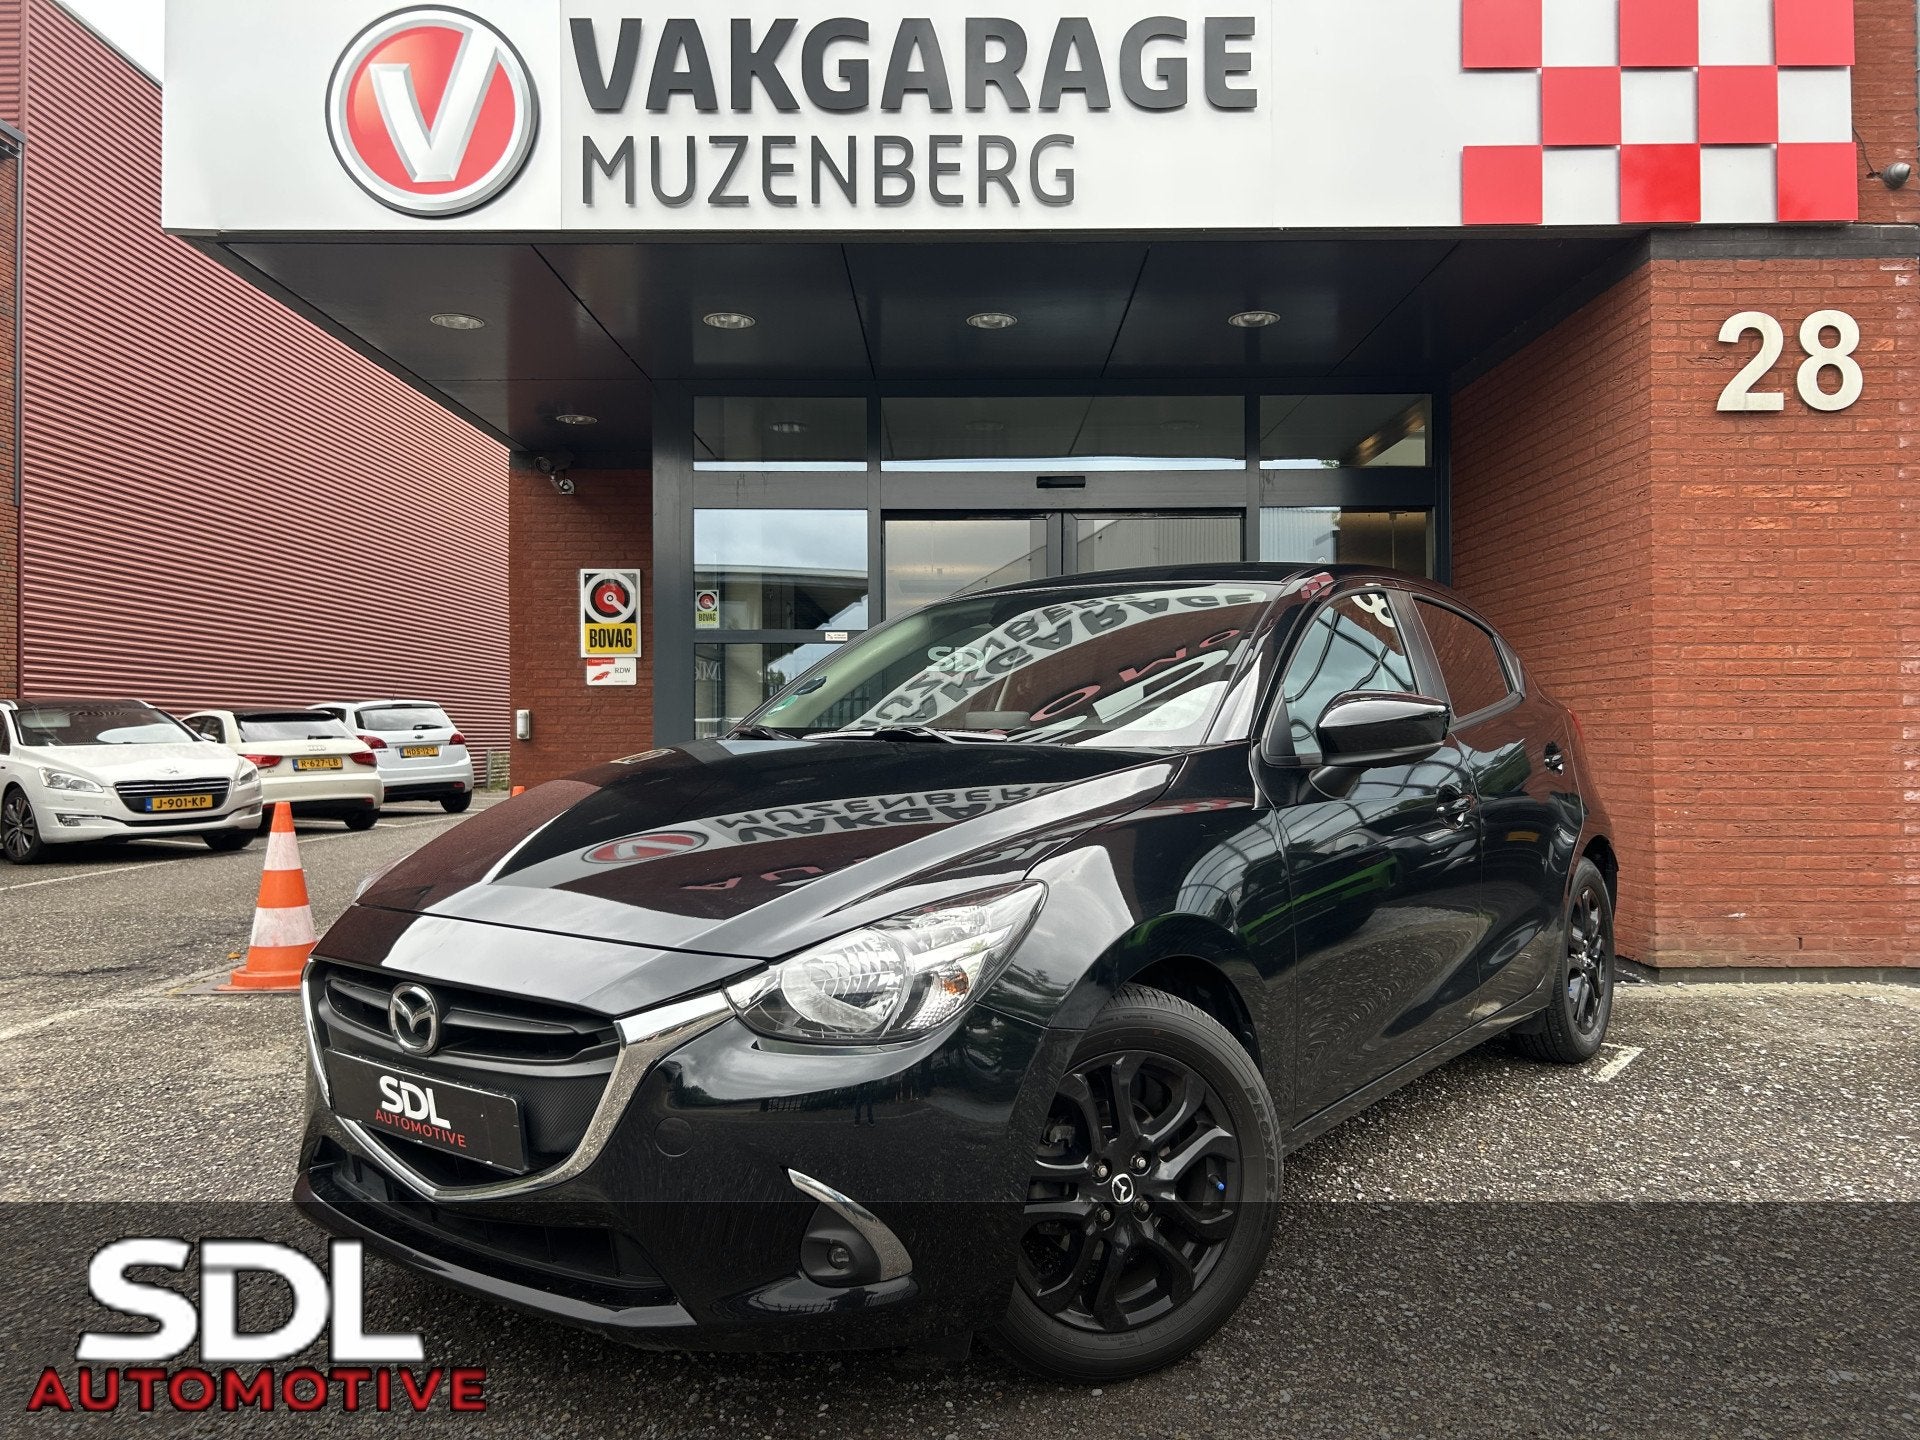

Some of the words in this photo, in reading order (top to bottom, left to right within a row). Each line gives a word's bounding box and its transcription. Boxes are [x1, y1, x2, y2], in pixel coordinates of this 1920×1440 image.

[569, 16, 1257, 112] VAKGARAGE
[582, 133, 1075, 208] MUZENBERG
[1716, 309, 1863, 411] 28
[589, 628, 633, 648] BOVAG
[156, 796, 207, 809] J-901-KP
[375, 1108, 467, 1148] AUTOMOTIVE
[379, 1075, 451, 1130] SDL
